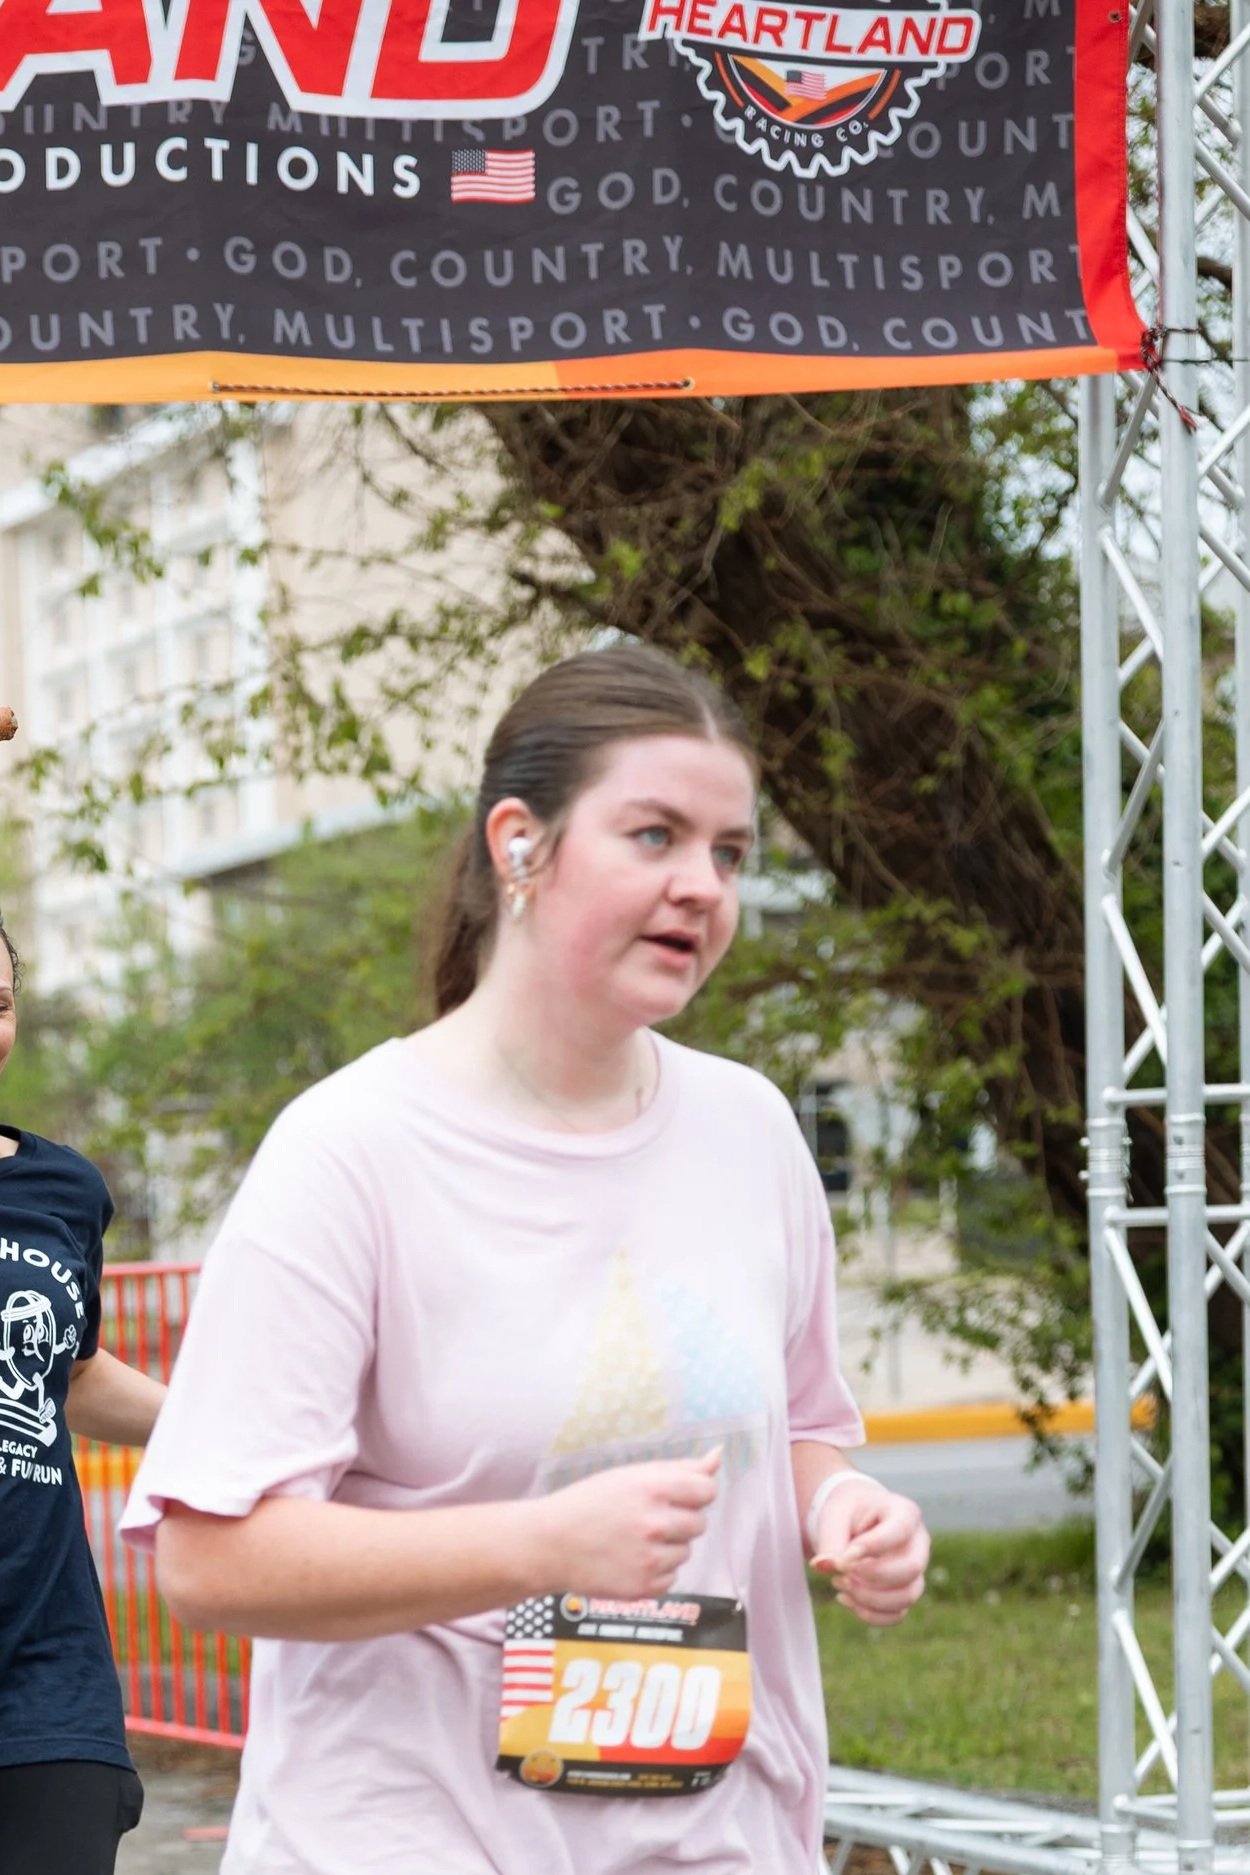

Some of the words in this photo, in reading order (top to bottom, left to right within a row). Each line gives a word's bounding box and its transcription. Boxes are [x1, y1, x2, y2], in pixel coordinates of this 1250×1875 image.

[648, 0, 975, 57] HEARTLAND
[744, 105, 824, 148] RACING
[836, 119, 869, 142] CO.
[881, 112, 1074, 160] OUNT
[547, 167, 689, 214] GOD,
[713, 173, 996, 226] COUNTRY,
[224, 236, 363, 288] GOD,
[390, 236, 693, 289] COUNTRY,
[273, 304, 666, 354] MULTISPORT
[722, 306, 861, 353] GOD,
[0, 1237, 84, 1320] HOUSE
[11, 1458, 34, 1480] FU
[33, 1463, 63, 1486] RUN
[547, 1656, 722, 1750] 2300
